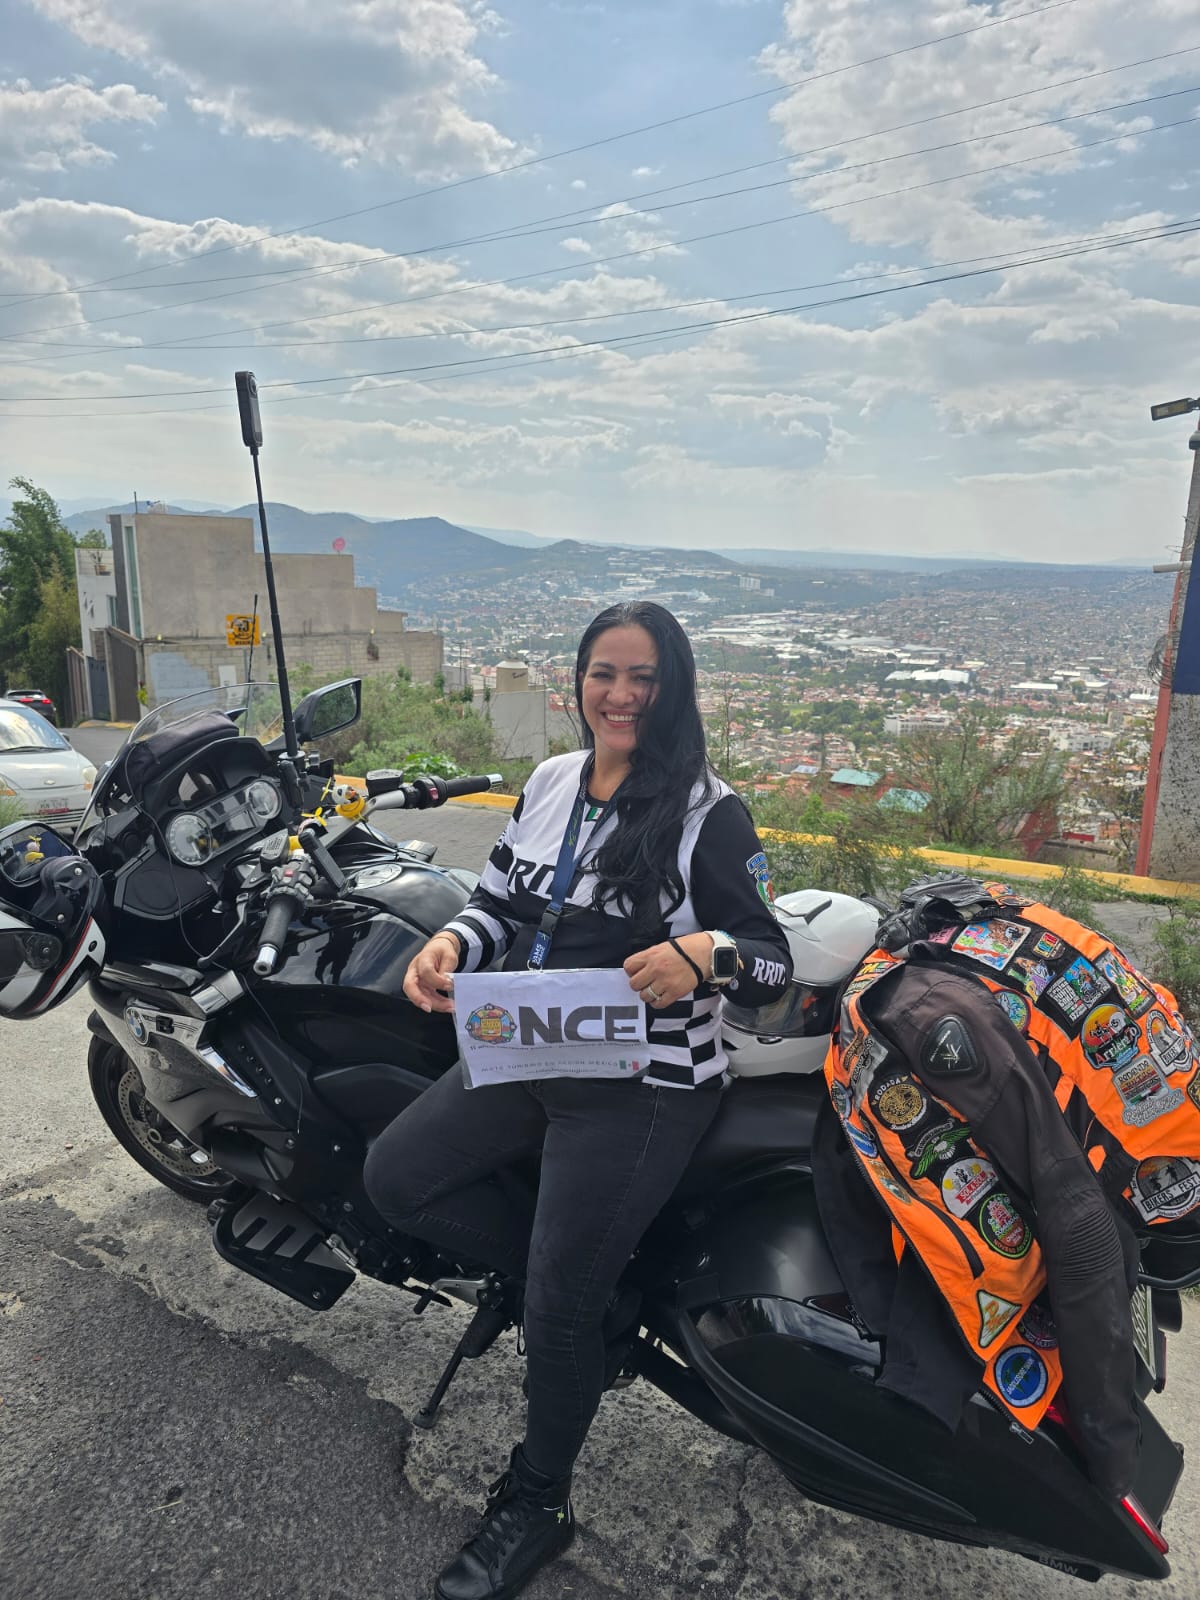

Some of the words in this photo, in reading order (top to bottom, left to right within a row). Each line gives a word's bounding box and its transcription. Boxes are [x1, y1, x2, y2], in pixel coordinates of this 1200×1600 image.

[875, 1077, 901, 1101] RODADA
[1144, 1189, 1174, 1210] BIKERS
[1178, 1176, 1199, 1193] FEST
[1039, 1552, 1078, 1575] BMW
